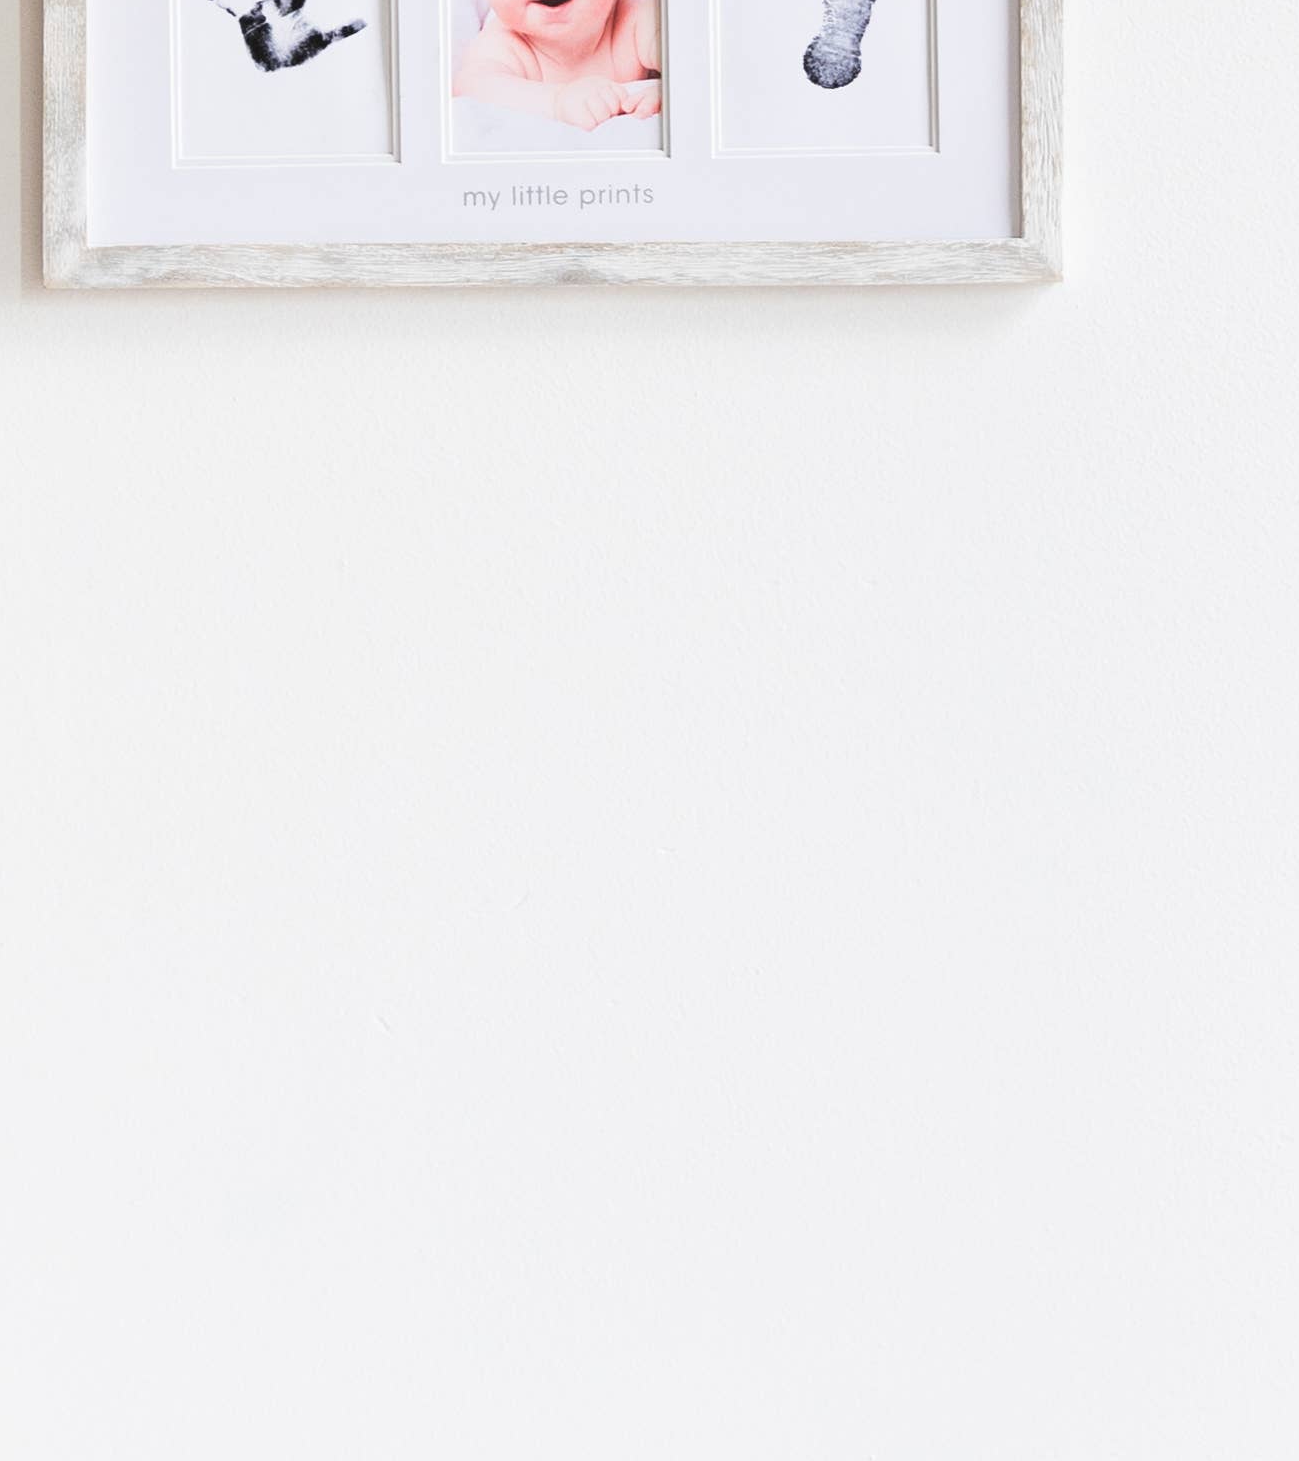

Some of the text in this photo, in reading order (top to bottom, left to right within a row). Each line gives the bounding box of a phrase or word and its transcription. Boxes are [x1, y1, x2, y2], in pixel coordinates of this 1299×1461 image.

[462, 183, 655, 211] my little prints
